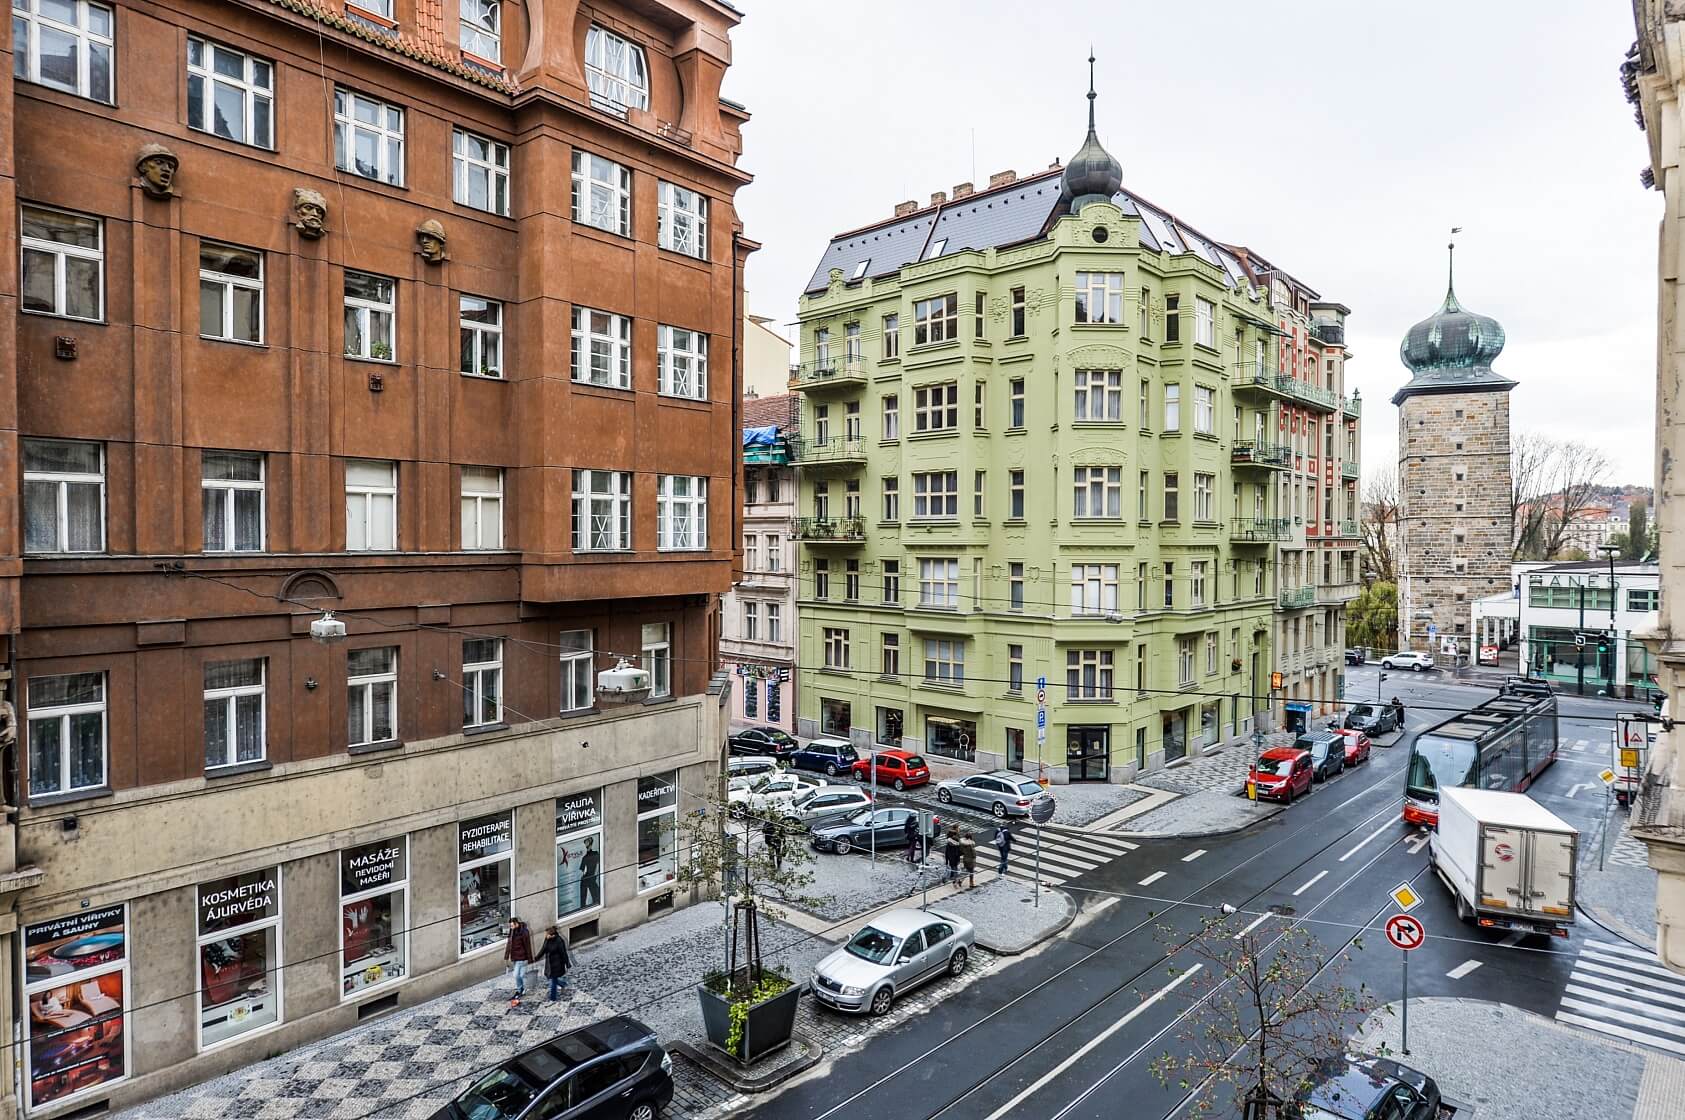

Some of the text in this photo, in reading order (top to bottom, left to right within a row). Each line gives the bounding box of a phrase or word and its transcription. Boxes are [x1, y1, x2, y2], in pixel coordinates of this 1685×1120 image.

[564, 797, 594, 811] SAUNA
[562, 808, 596, 823] VÍŘIVKA
[462, 820, 510, 840] FYZIOTERAPIE
[463, 832, 510, 853] REHABILITACE
[350, 847, 400, 869] MASÁŽE
[355, 860, 394, 878] NEVIDOMÍ
[360, 871, 390, 886] MASÉŘI
[202, 880, 275, 907] KOSMETIKA
[206, 895, 272, 921] ÁJURVÉDA
[28, 908, 121, 936] PRIVÁTNÍ VÍŘIVKY
[62, 921, 100, 936] SAUNY
